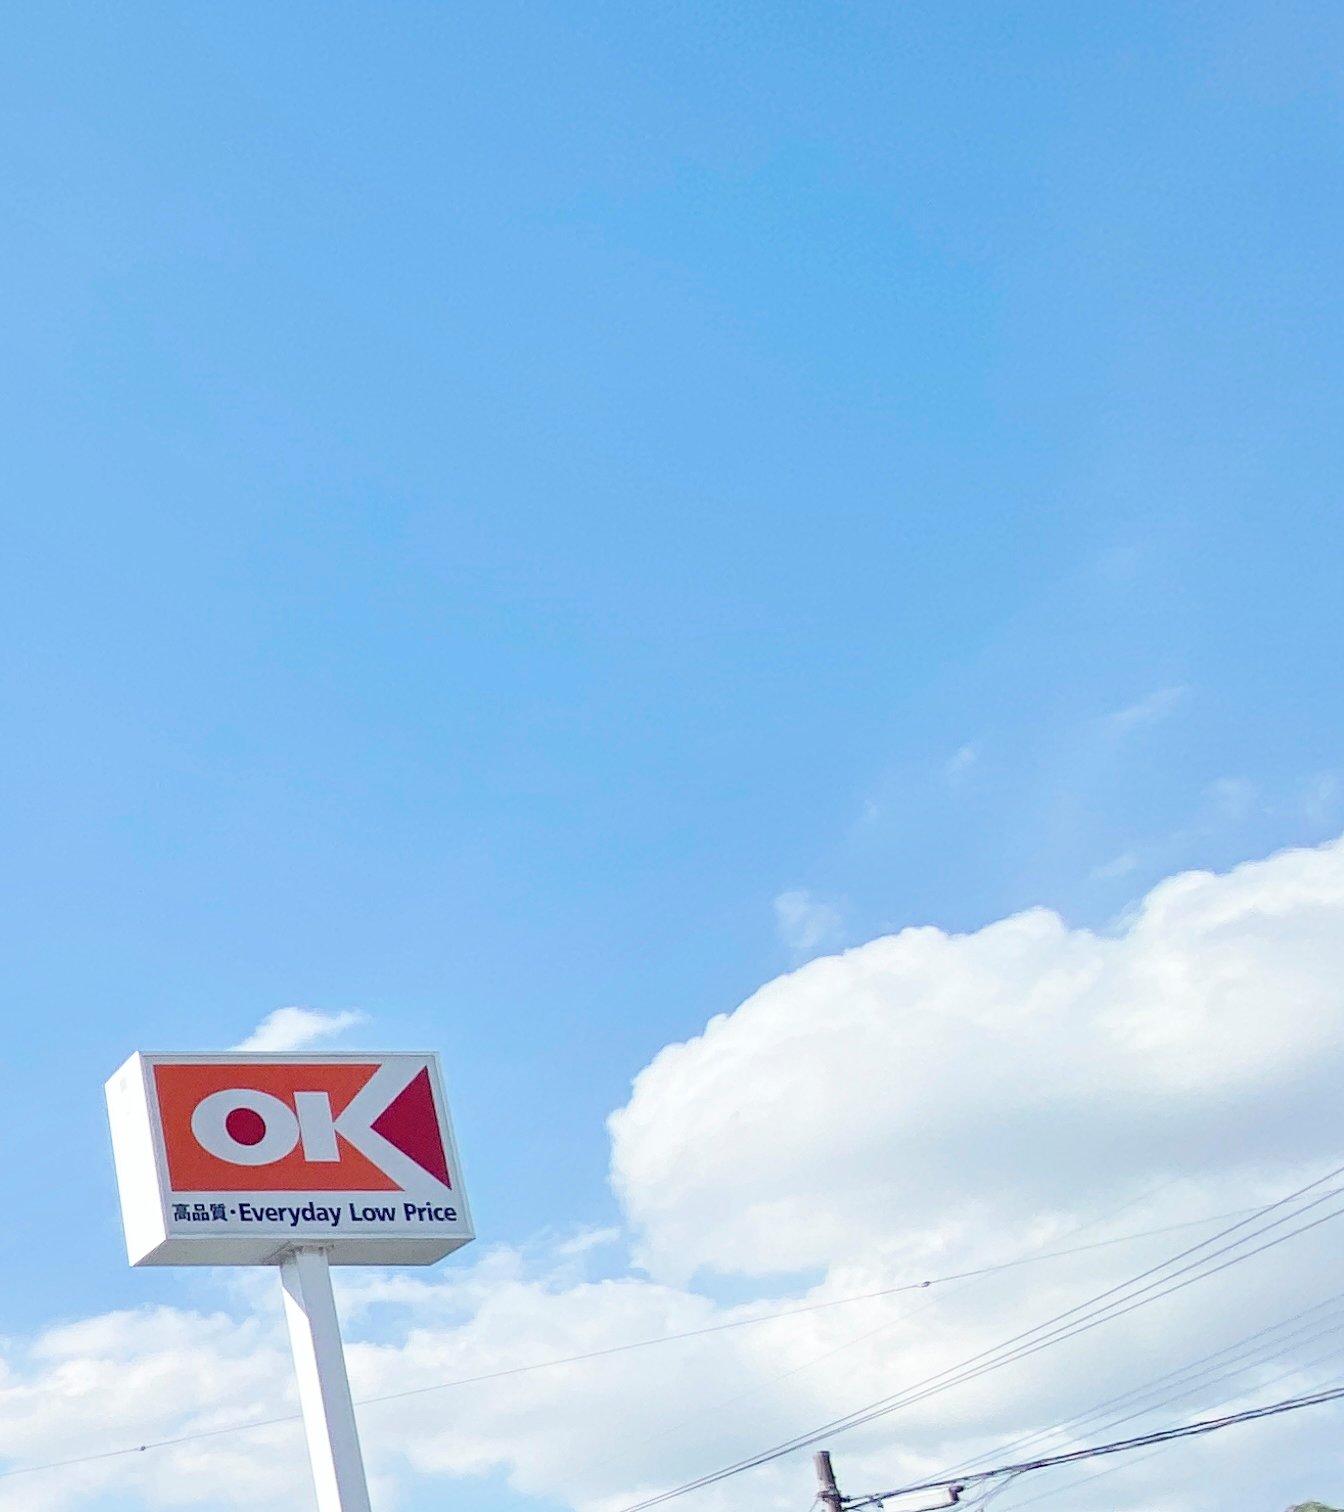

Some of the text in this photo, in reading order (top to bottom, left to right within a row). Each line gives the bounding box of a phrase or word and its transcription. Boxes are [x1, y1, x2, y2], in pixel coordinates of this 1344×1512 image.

[191, 1064, 451, 1191] OK
[349, 1201, 396, 1222] Low
[404, 1201, 457, 1222] Price
